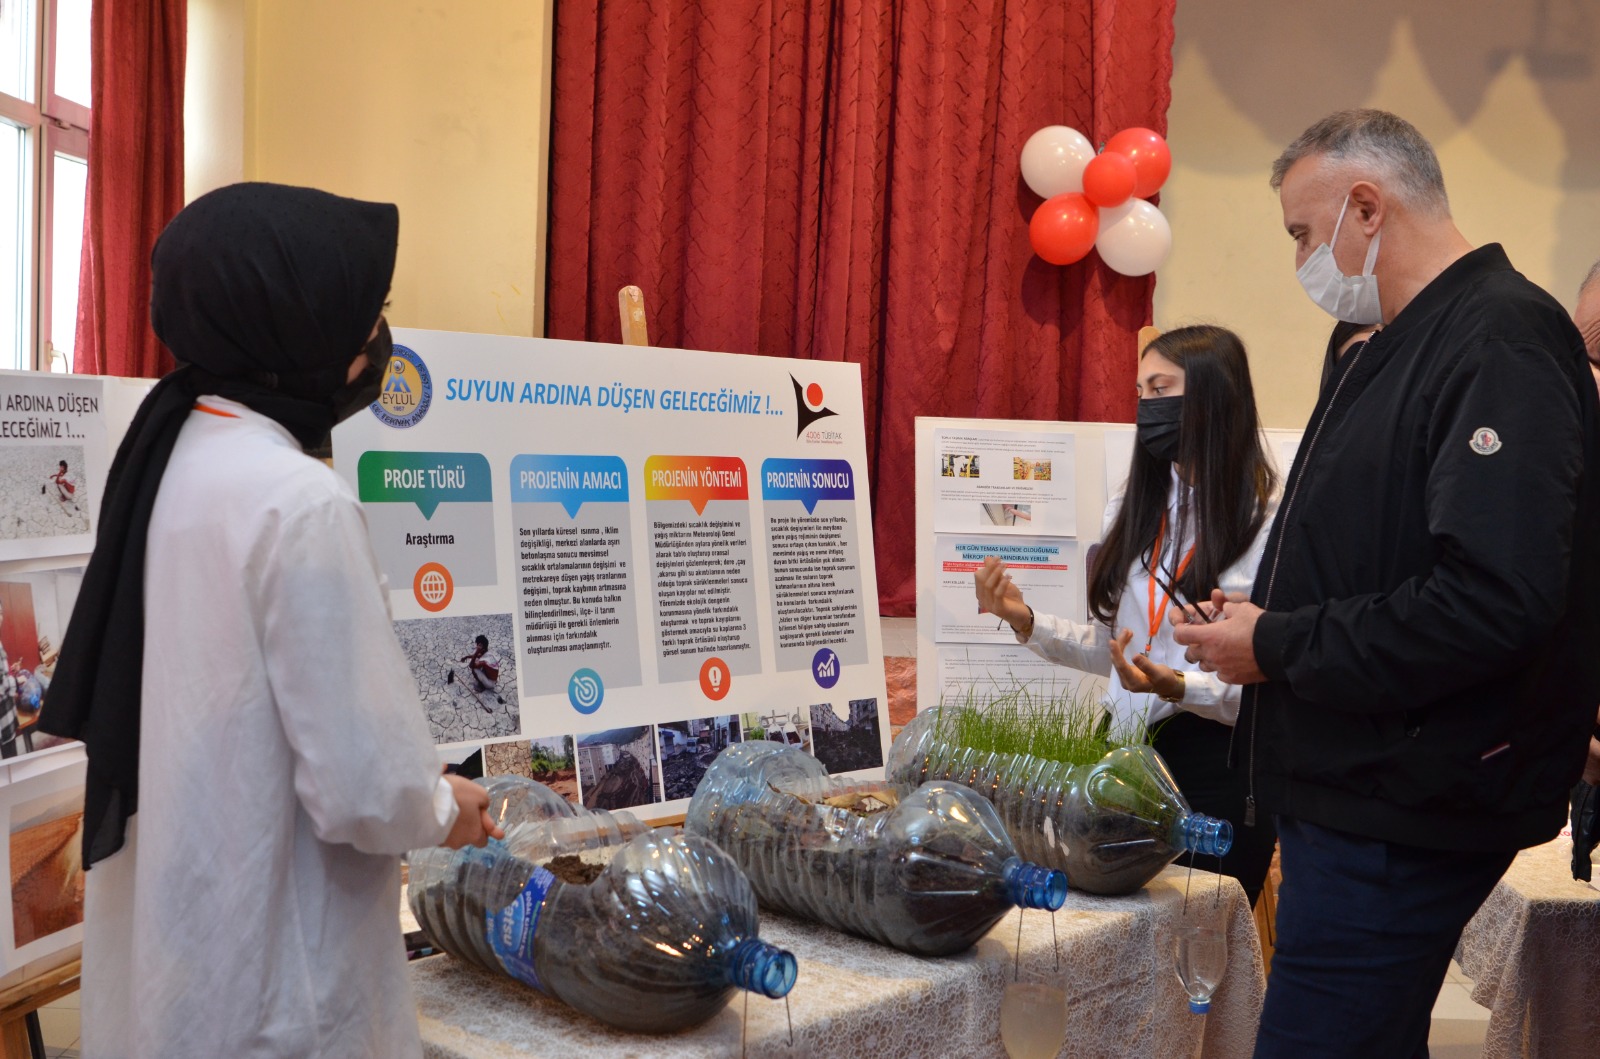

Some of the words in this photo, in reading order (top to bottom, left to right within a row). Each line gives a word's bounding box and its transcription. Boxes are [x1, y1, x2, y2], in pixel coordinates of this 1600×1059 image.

[382, 391, 416, 405] EYLÜL
[446, 378, 515, 403] SUYUN
[519, 382, 592, 407] ARDINA
[597, 382, 655, 413] DÜŞEN
[660, 388, 761, 414] GELECEĞİMİZ
[6, 394, 54, 412] ARDINA
[58, 393, 99, 417] DÜŞEN
[821, 431, 842, 440] TÜBİTAK
[384, 469, 425, 488] PROJE
[428, 465, 465, 488] TÜRÜ
[520, 466, 579, 489] PROJENİN
[583, 471, 621, 489] AMACI
[652, 466, 698, 487] PROJENİN
[699, 467, 742, 488] YÖNTEMİ
[767, 469, 811, 488] PROJENİN
[812, 472, 849, 488] SONUCU
[519, 527, 531, 536] Son
[532, 527, 555, 537] yıllarda
[555, 527, 578, 536] küresel
[604, 526, 619, 534] iklim
[405, 533, 455, 548] Araştırma
[555, 538, 578, 547] merkezi
[579, 538, 607, 547] alanlarda
[607, 539, 620, 547] aşırı
[520, 551, 556, 561] betonlaşma
[556, 551, 578, 559] sonucu
[578, 549, 609, 558] mevsimsel
[521, 562, 546, 572] sıcaklık
[546, 562, 592, 571] ortalamalarının
[592, 560, 617, 571] değişimi
[522, 574, 560, 584] metrekareye
[561, 573, 579, 583] düşen
[579, 572, 595, 582] yağış
[596, 572, 627, 580] oranlarının
[552, 585, 572, 595] toprak
[572, 584, 598, 594] kaybının
[598, 584, 627, 592] artmasına
[524, 598, 543, 607] neden
[572, 596, 581, 605] Bu
[581, 595, 603, 604] konuda
[603, 594, 622, 603] halkın
[594, 606, 599, 615] il
[558, 620, 567, 629] ile
[567, 619, 588, 630] gerekli
[589, 617, 620, 627] önlemlerin
[526, 634, 552, 643] alınması
[553, 632, 565, 643] için
[565, 629, 598, 640] farkındalık
[527, 644, 568, 656] oluşturulması
[569, 641, 612, 652] amaçlanmıştır.
